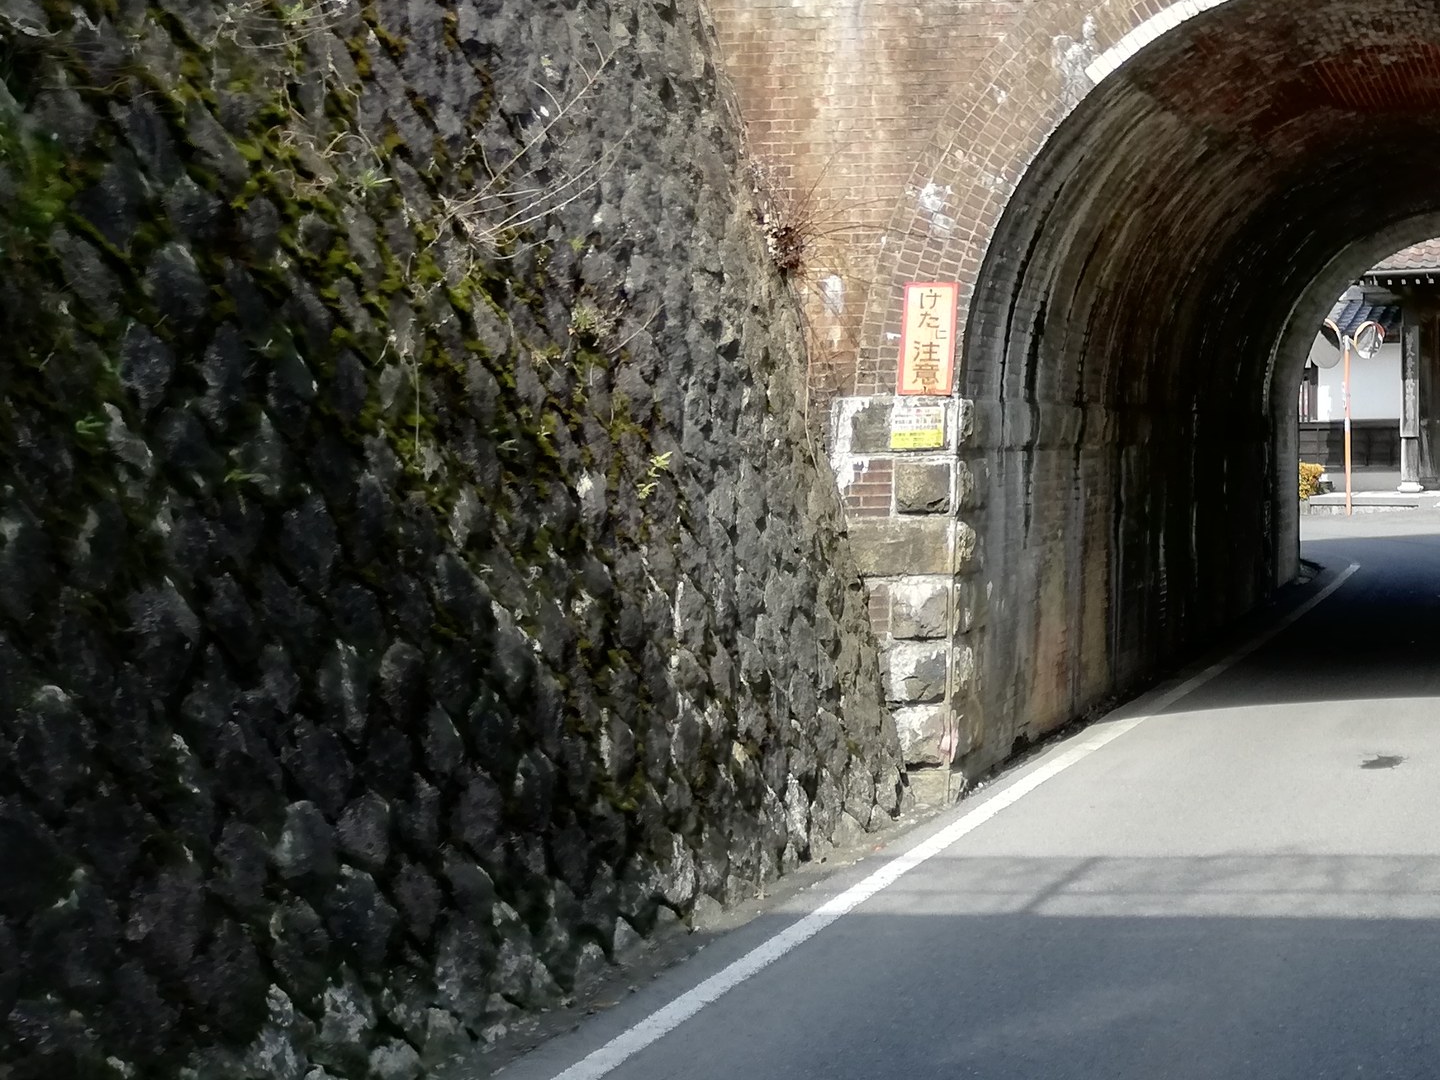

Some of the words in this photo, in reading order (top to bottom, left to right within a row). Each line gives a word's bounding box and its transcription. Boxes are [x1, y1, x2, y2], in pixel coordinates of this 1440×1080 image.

[911, 291, 948, 386] けたに注意
